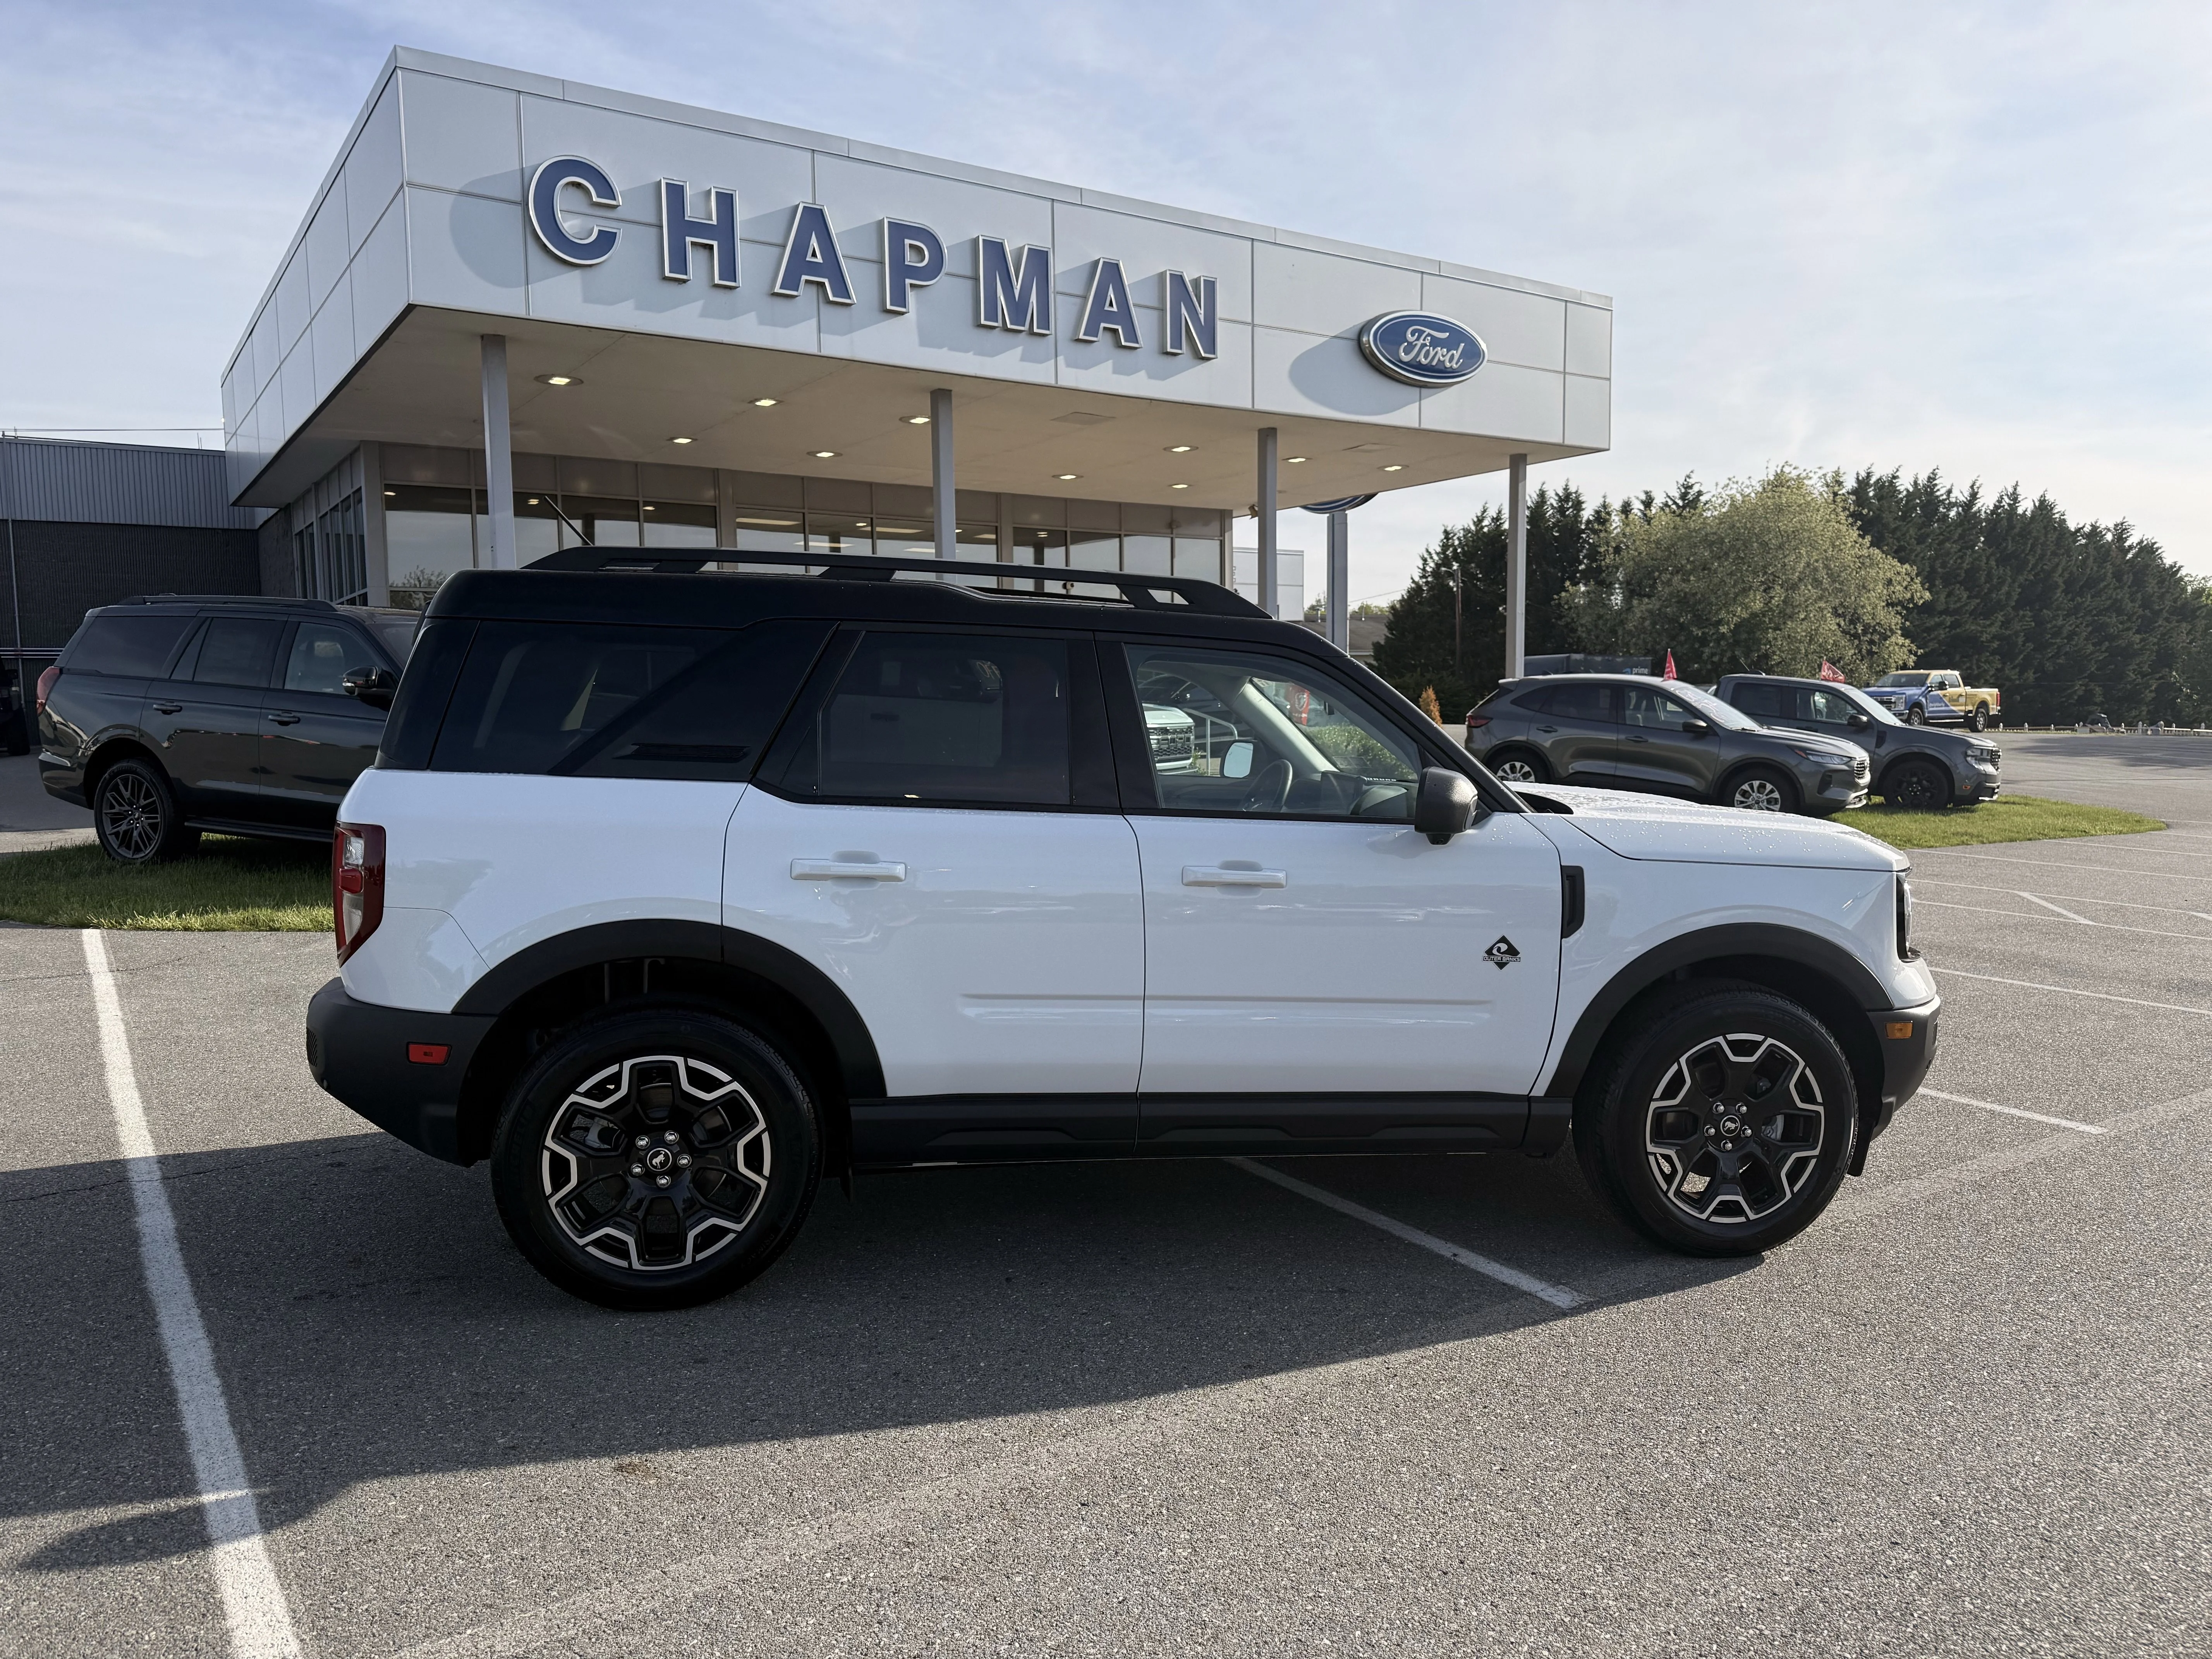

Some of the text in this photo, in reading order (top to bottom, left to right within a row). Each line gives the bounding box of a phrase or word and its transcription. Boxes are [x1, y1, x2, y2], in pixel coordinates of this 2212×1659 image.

[528, 154, 1218, 361] CHAPMAN
[1398, 326, 1465, 369] Ford
[1632, 666, 1648, 675] prime
